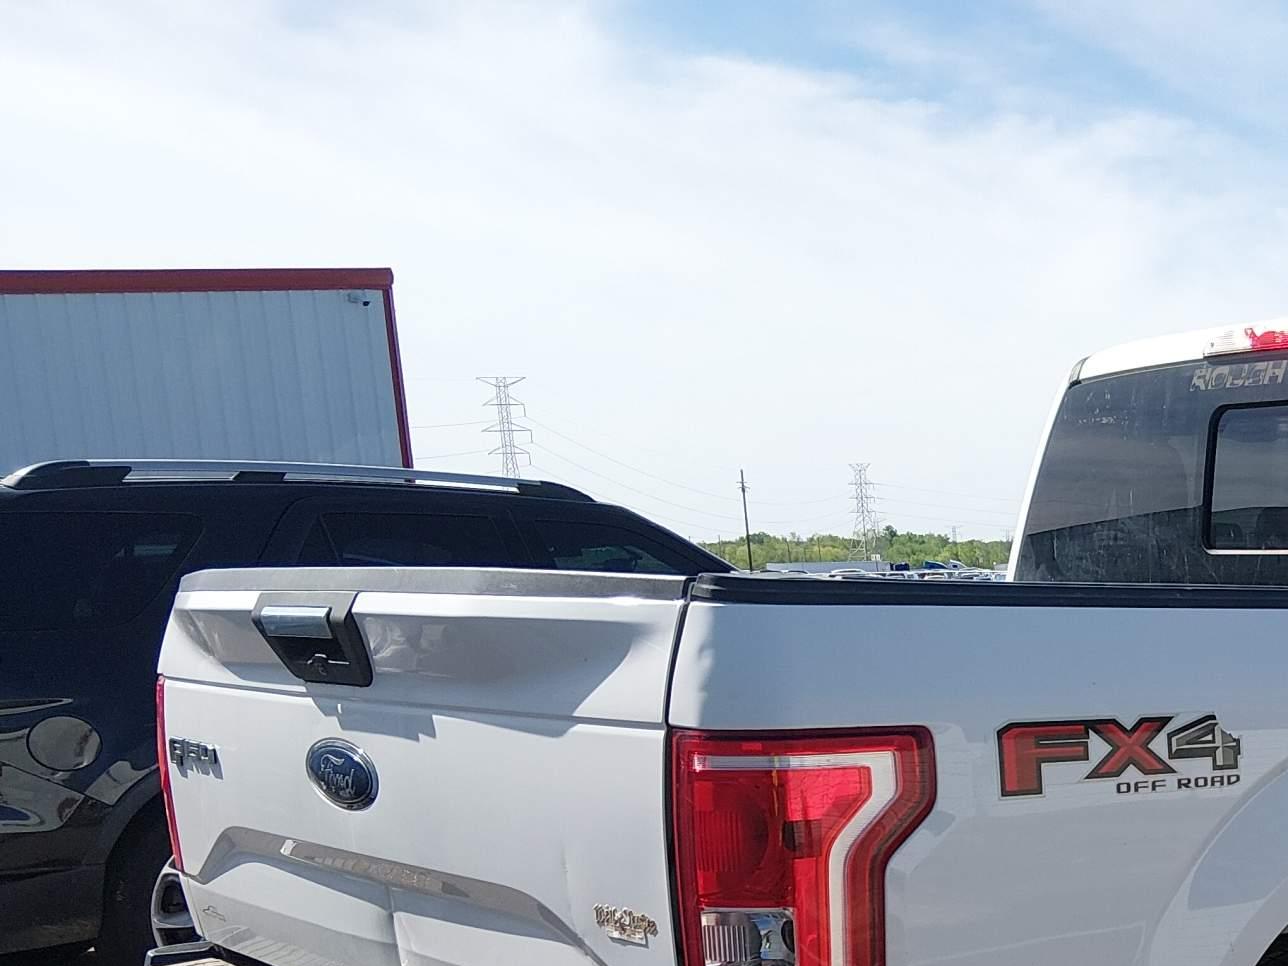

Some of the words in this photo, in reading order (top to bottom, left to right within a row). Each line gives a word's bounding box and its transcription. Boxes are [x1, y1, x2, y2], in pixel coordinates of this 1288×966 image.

[319, 753, 356, 797] Ford
[997, 713, 1241, 798] FX4
[1116, 778, 1167, 795] OFF
[1177, 774, 1241, 791] ROAD
